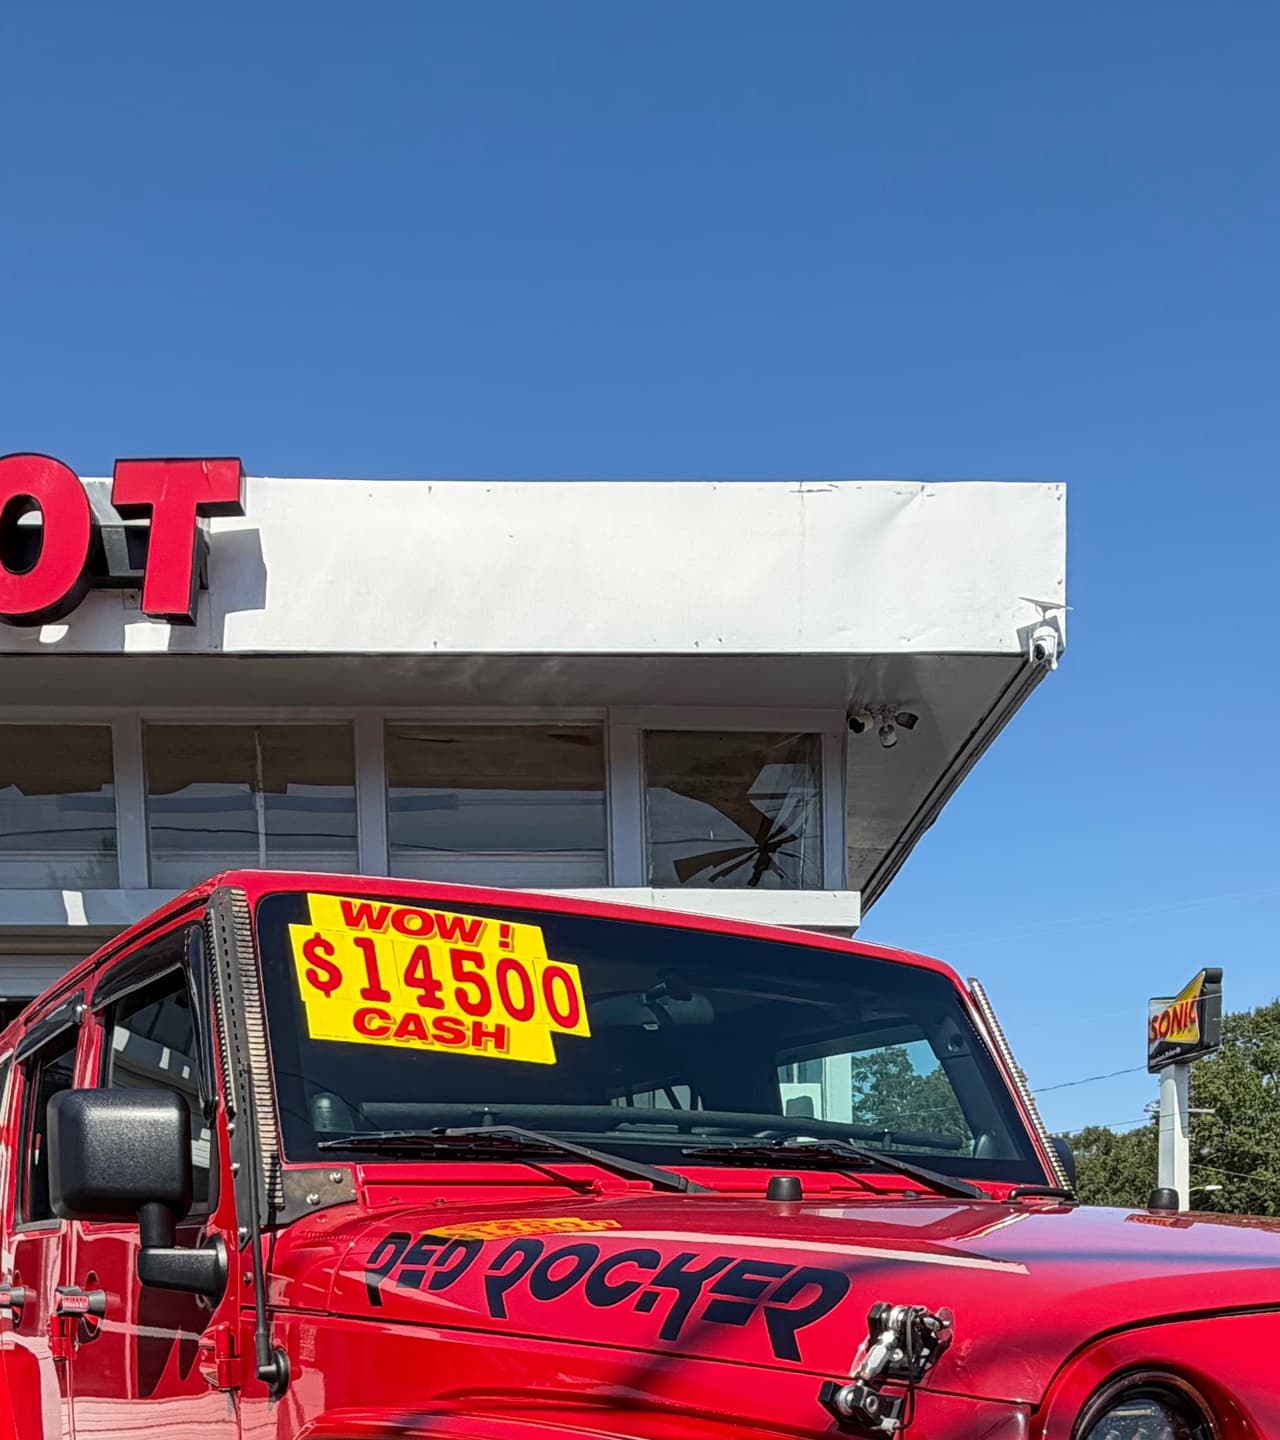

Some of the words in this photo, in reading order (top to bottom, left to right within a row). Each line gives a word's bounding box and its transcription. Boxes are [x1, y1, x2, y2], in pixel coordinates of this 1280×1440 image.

[302, 932, 581, 1030] $14500
[352, 1007, 510, 1055] CASH
[1149, 994, 1200, 1044] SONIC
[364, 1230, 486, 1308] RED
[483, 1237, 852, 1363] ROCKER
